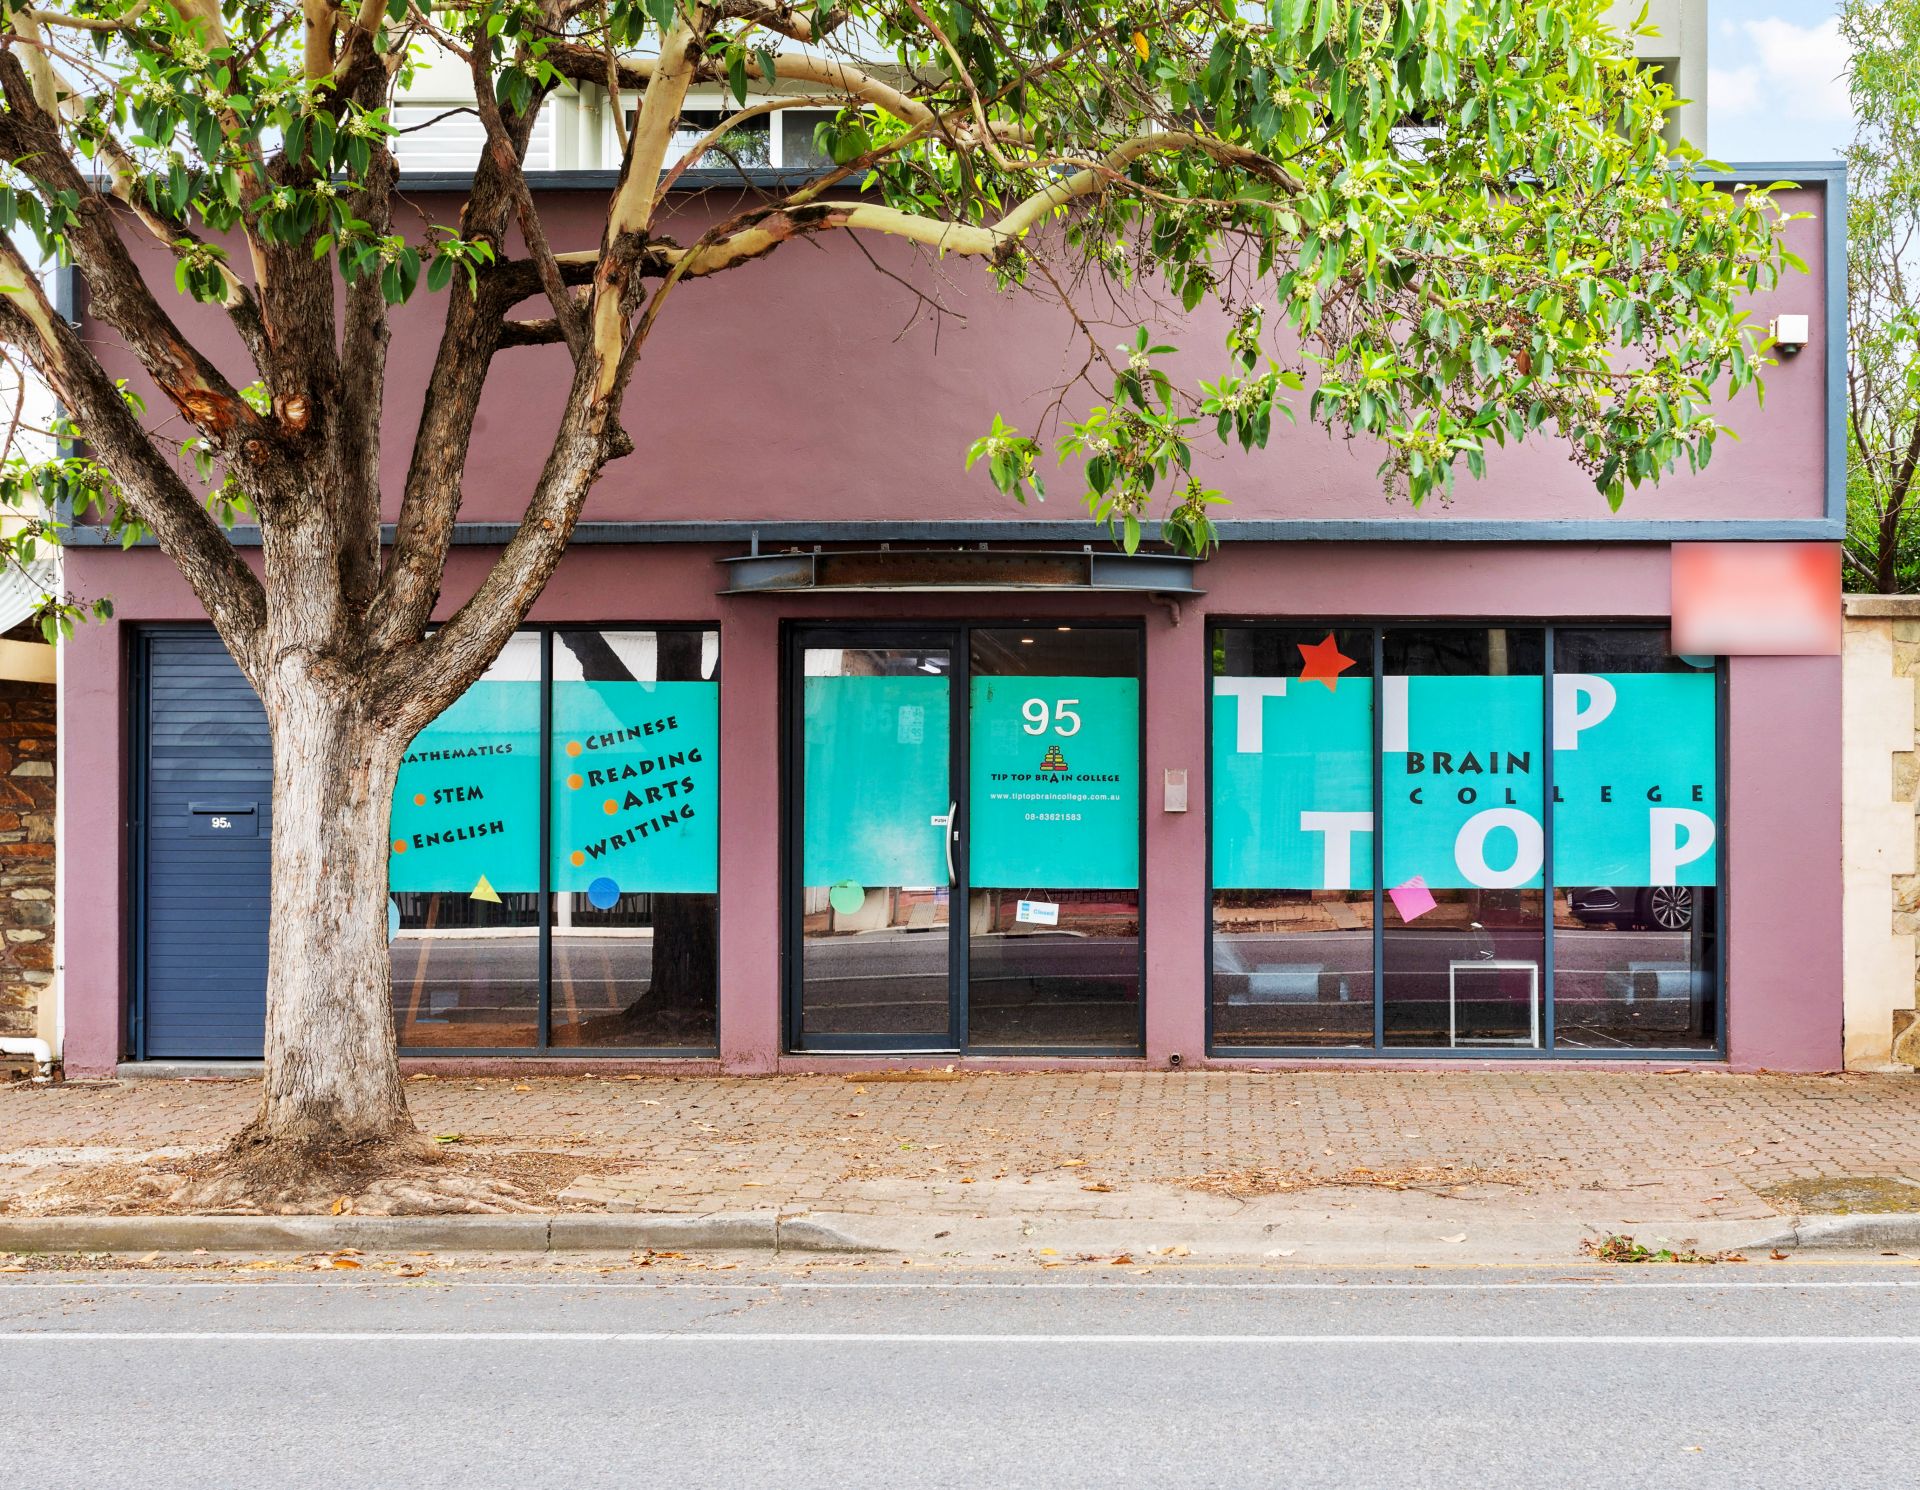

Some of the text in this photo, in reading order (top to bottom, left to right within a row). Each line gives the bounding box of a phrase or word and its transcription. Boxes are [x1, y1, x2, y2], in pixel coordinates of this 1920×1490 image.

[1021, 698, 1081, 737] 95
[1214, 674, 1617, 754] TIP
[585, 715, 678, 750] CHINESE
[587, 747, 703, 788] READING
[990, 772, 1120, 784] TIP TOP BRAIN COLLEGE
[1406, 751, 1531, 775] BRAIN
[433, 785, 484, 805] STEM
[622, 775, 695, 811] ARTS
[990, 793, 1120, 802] www.tiptopbraincollege.com.au
[1409, 784, 1703, 805] COLLEGE
[211, 816, 232, 829] 95A
[412, 820, 505, 849] ENGLISH
[584, 803, 695, 860] WRITING
[1300, 807, 1716, 889] TOP
